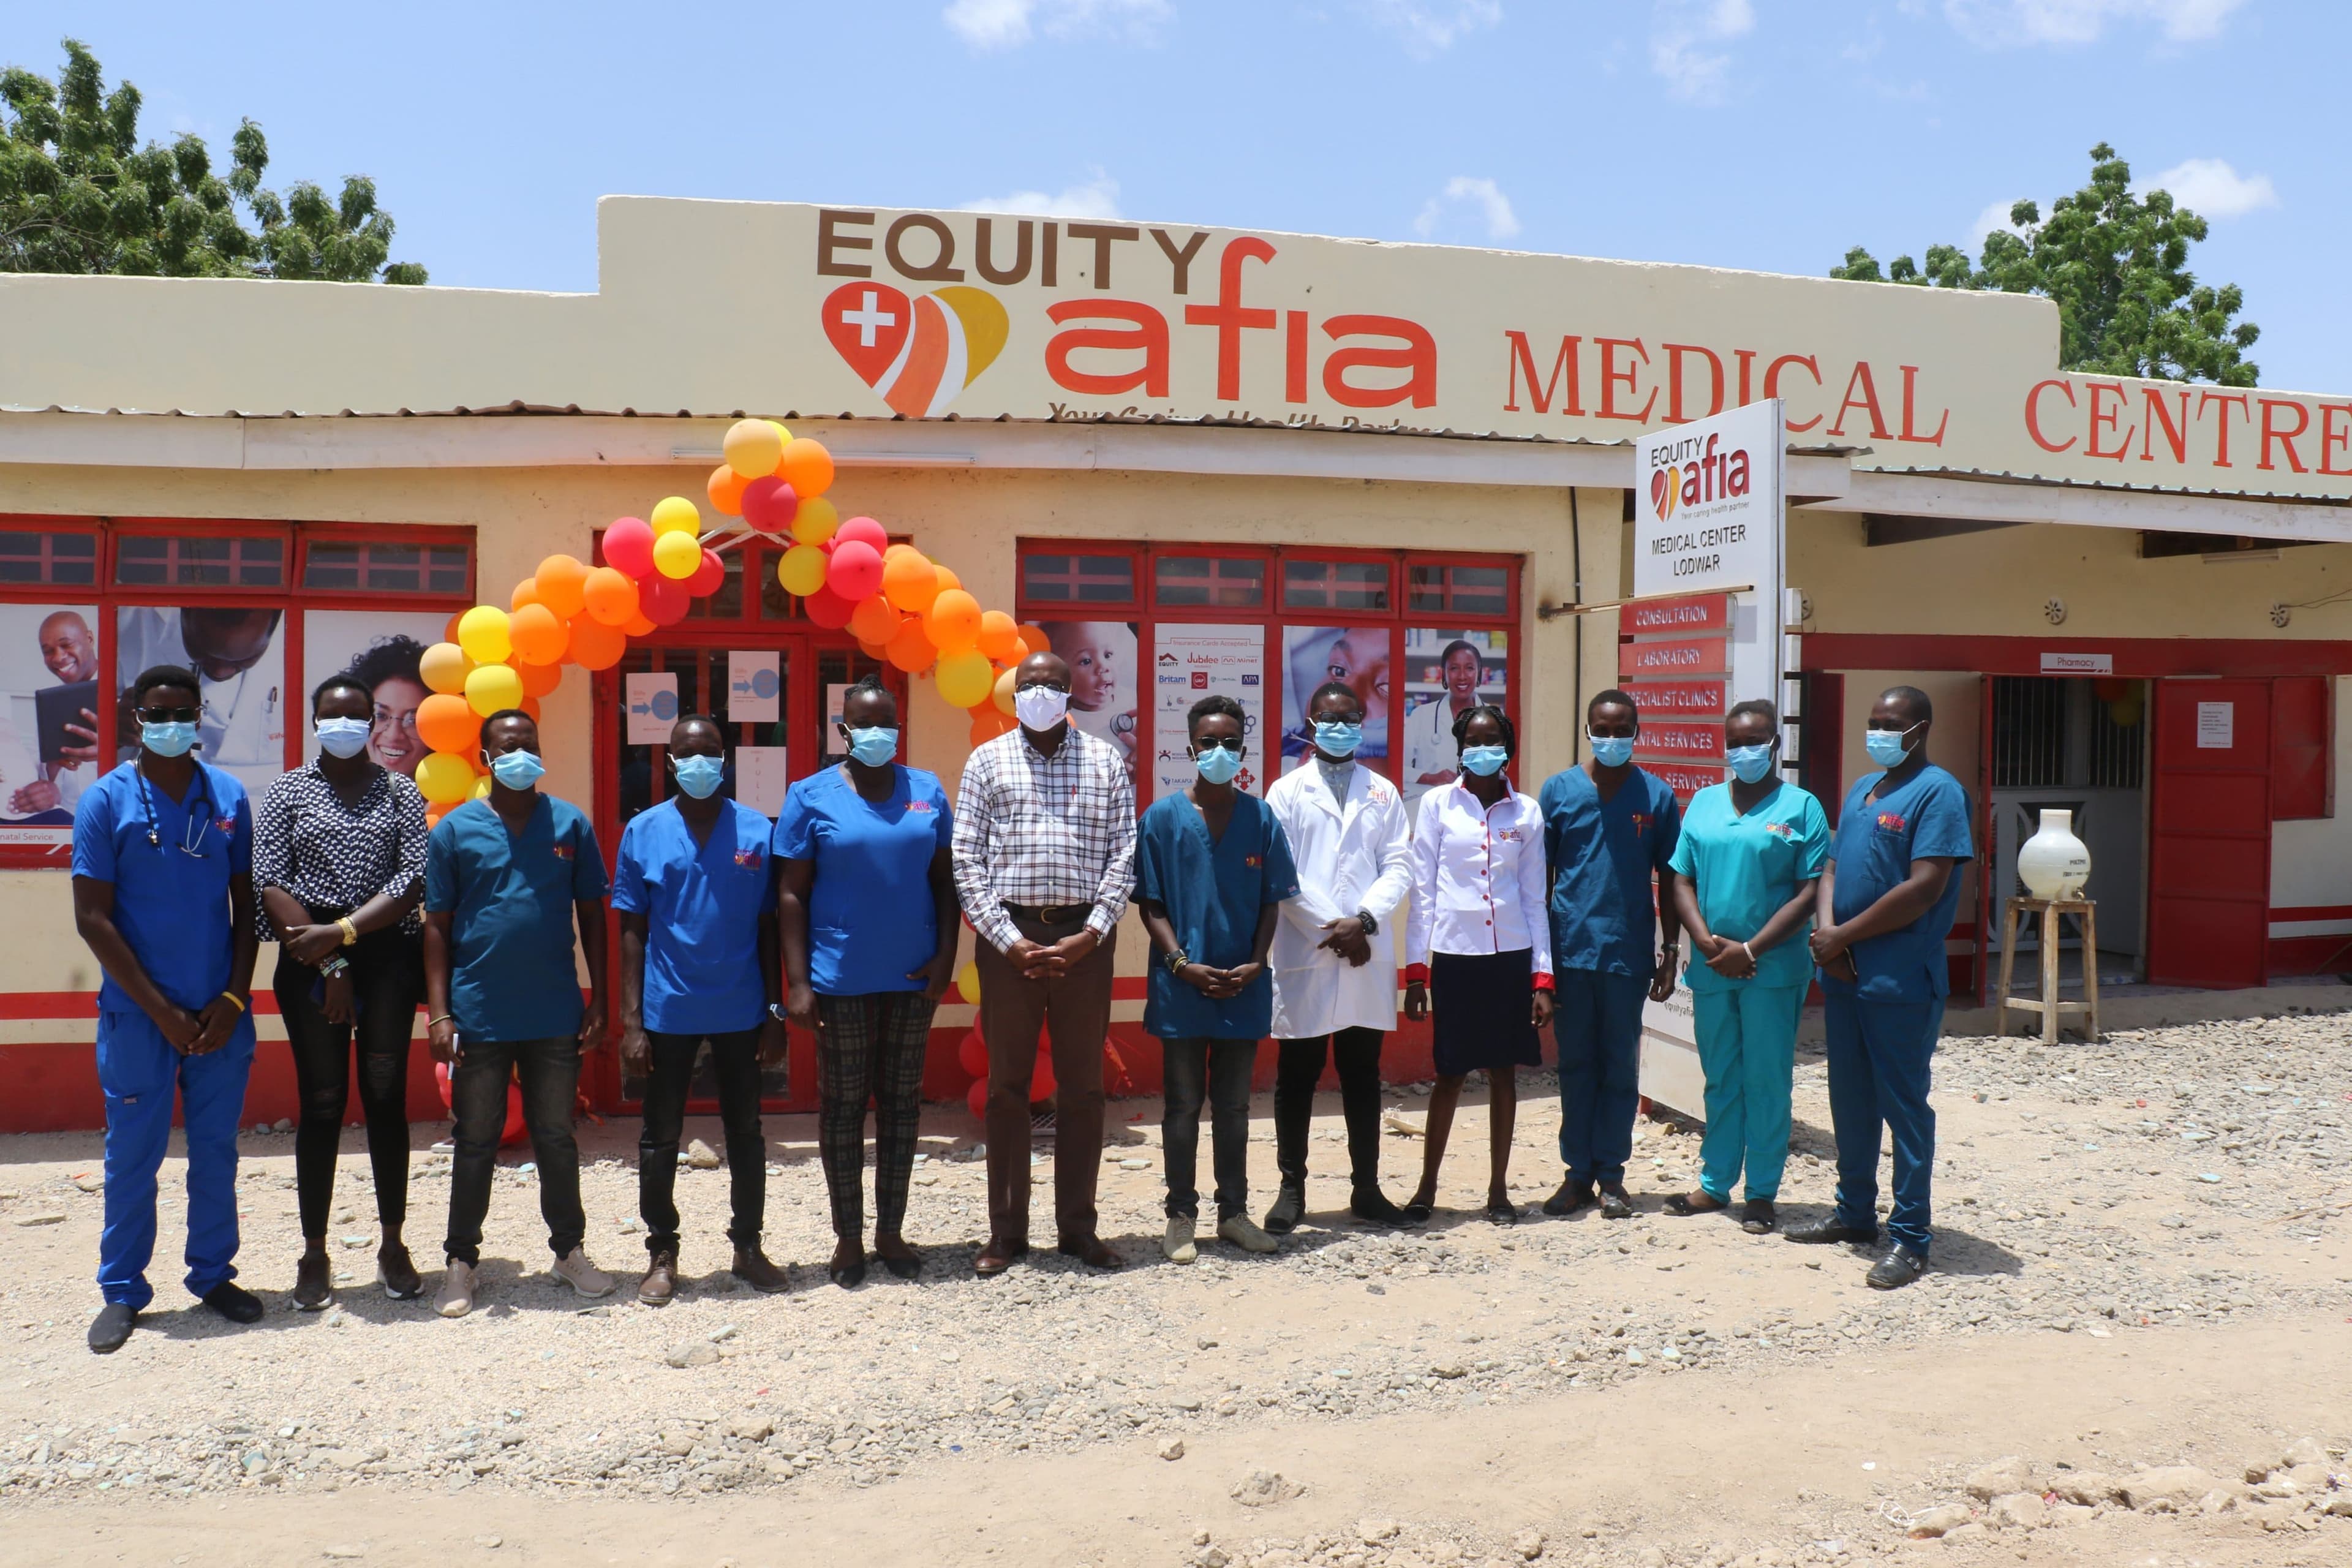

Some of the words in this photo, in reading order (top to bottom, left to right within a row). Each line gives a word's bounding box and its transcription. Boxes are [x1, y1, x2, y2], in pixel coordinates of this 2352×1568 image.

[817, 209, 1210, 295] EQUITY
[1044, 236, 1438, 409] afia
[1504, 330, 1949, 447] MEDICAL
[2025, 379, 2352, 476] CENTRE
[1651, 435, 1703, 468] EQUITY
[1681, 432, 1750, 507] afia
[1694, 508, 1710, 518] caring
[1711, 503, 1728, 514] health
[1729, 501, 1750, 513] partner
[1652, 533, 1697, 556] MEDICAL
[1700, 524, 1746, 548] CENTER
[1674, 554, 1721, 576] LODWAR
[1636, 606, 1707, 626] CONSULTATION
[1187, 652, 1219, 664] Jubilee
[1637, 648, 1701, 667] LABORATORY
[2057, 657, 2095, 668] Pharmacy
[1159, 675, 1186, 684] Britam
[1626, 691, 1676, 706] PECIALIST
[1678, 691, 1718, 707] CLINICS
[1664, 731, 1713, 749] SERVICES
[1665, 773, 1714, 790] SERVICES
[23, 832, 54, 841] Service
